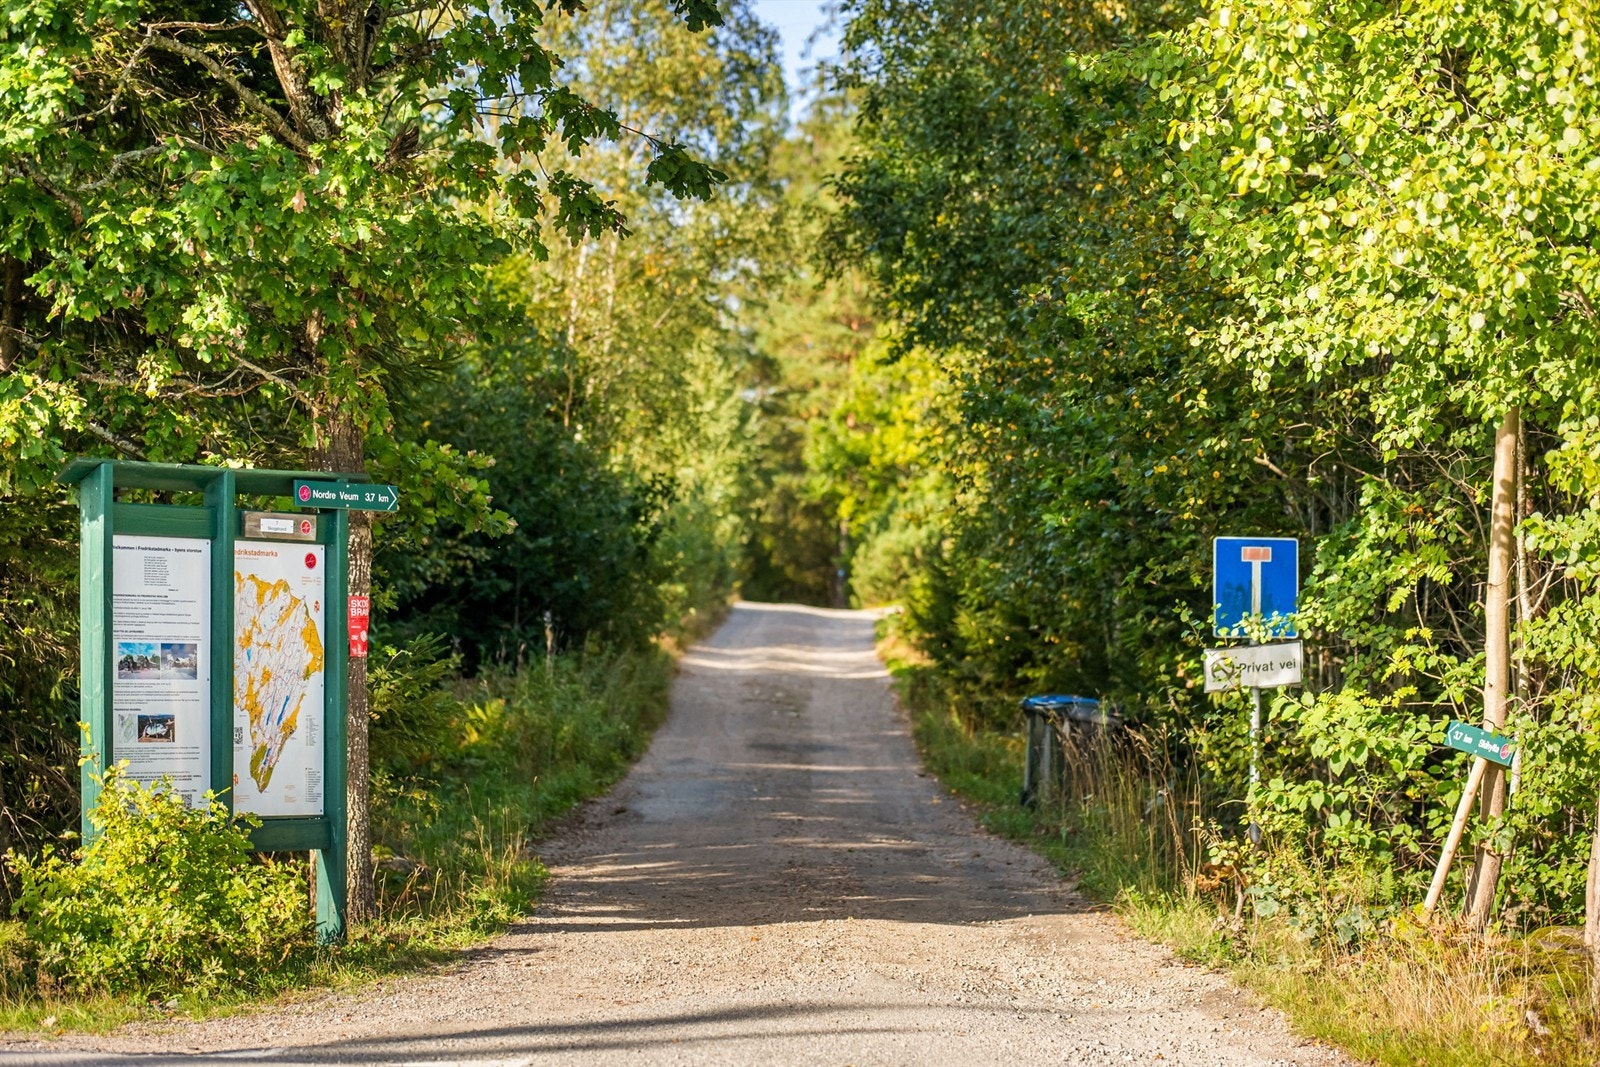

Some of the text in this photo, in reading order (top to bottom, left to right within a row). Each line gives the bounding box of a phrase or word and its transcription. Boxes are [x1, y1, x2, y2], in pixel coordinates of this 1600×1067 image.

[312, 489, 336, 500] Nordre
[339, 491, 358, 501] Veum
[378, 493, 389, 503] km
[1240, 658, 1296, 673] Privat vei
[1463, 734, 1473, 744] km
